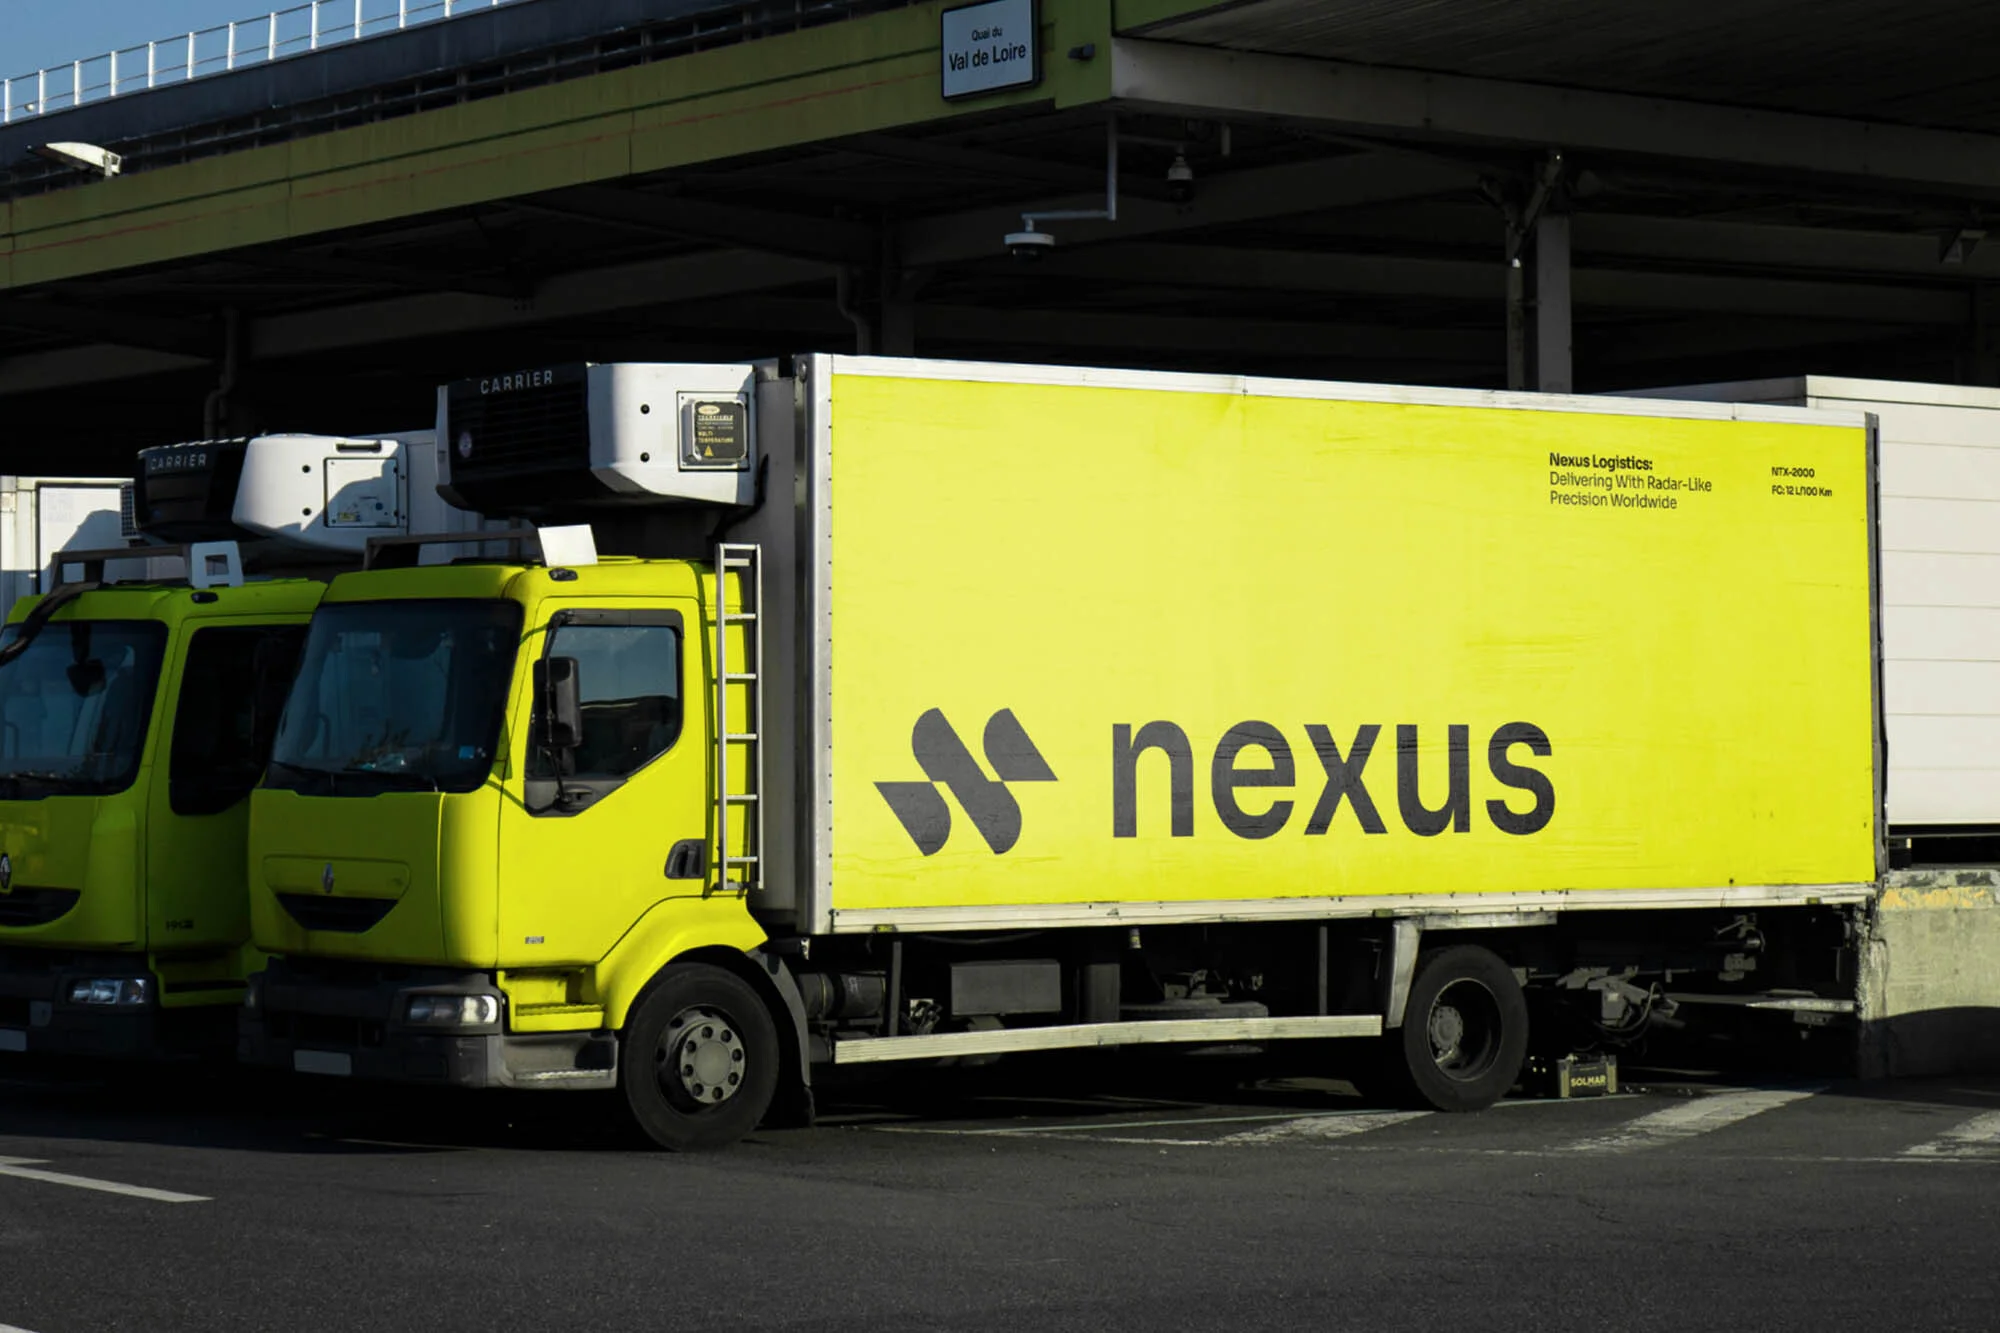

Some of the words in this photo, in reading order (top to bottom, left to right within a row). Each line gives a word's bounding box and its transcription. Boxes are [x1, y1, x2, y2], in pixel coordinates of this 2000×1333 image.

[971, 27, 990, 41] Quai
[992, 25, 1003, 38] du
[949, 51, 969, 71] Val
[972, 48, 989, 68] de
[992, 42, 1026, 63] Loire
[480, 370, 553, 394] CARRIER
[151, 453, 206, 470] CARRIER
[1549, 452, 1590, 468] Nexus
[1592, 454, 1653, 472] Logistics:
[1550, 471, 1613, 491] Delivering
[1615, 474, 1645, 489] With
[1647, 475, 1712, 492] Radar-Like
[1771, 466, 1815, 478] NTX-2000
[1550, 490, 1608, 507] Precision
[1610, 493, 1677, 509] Worldwide
[1786, 486, 1794, 495] 12
[1819, 488, 1832, 496] Km
[1112, 719, 1556, 840] nexus
[1571, 1075, 1606, 1087] SOLMAR
